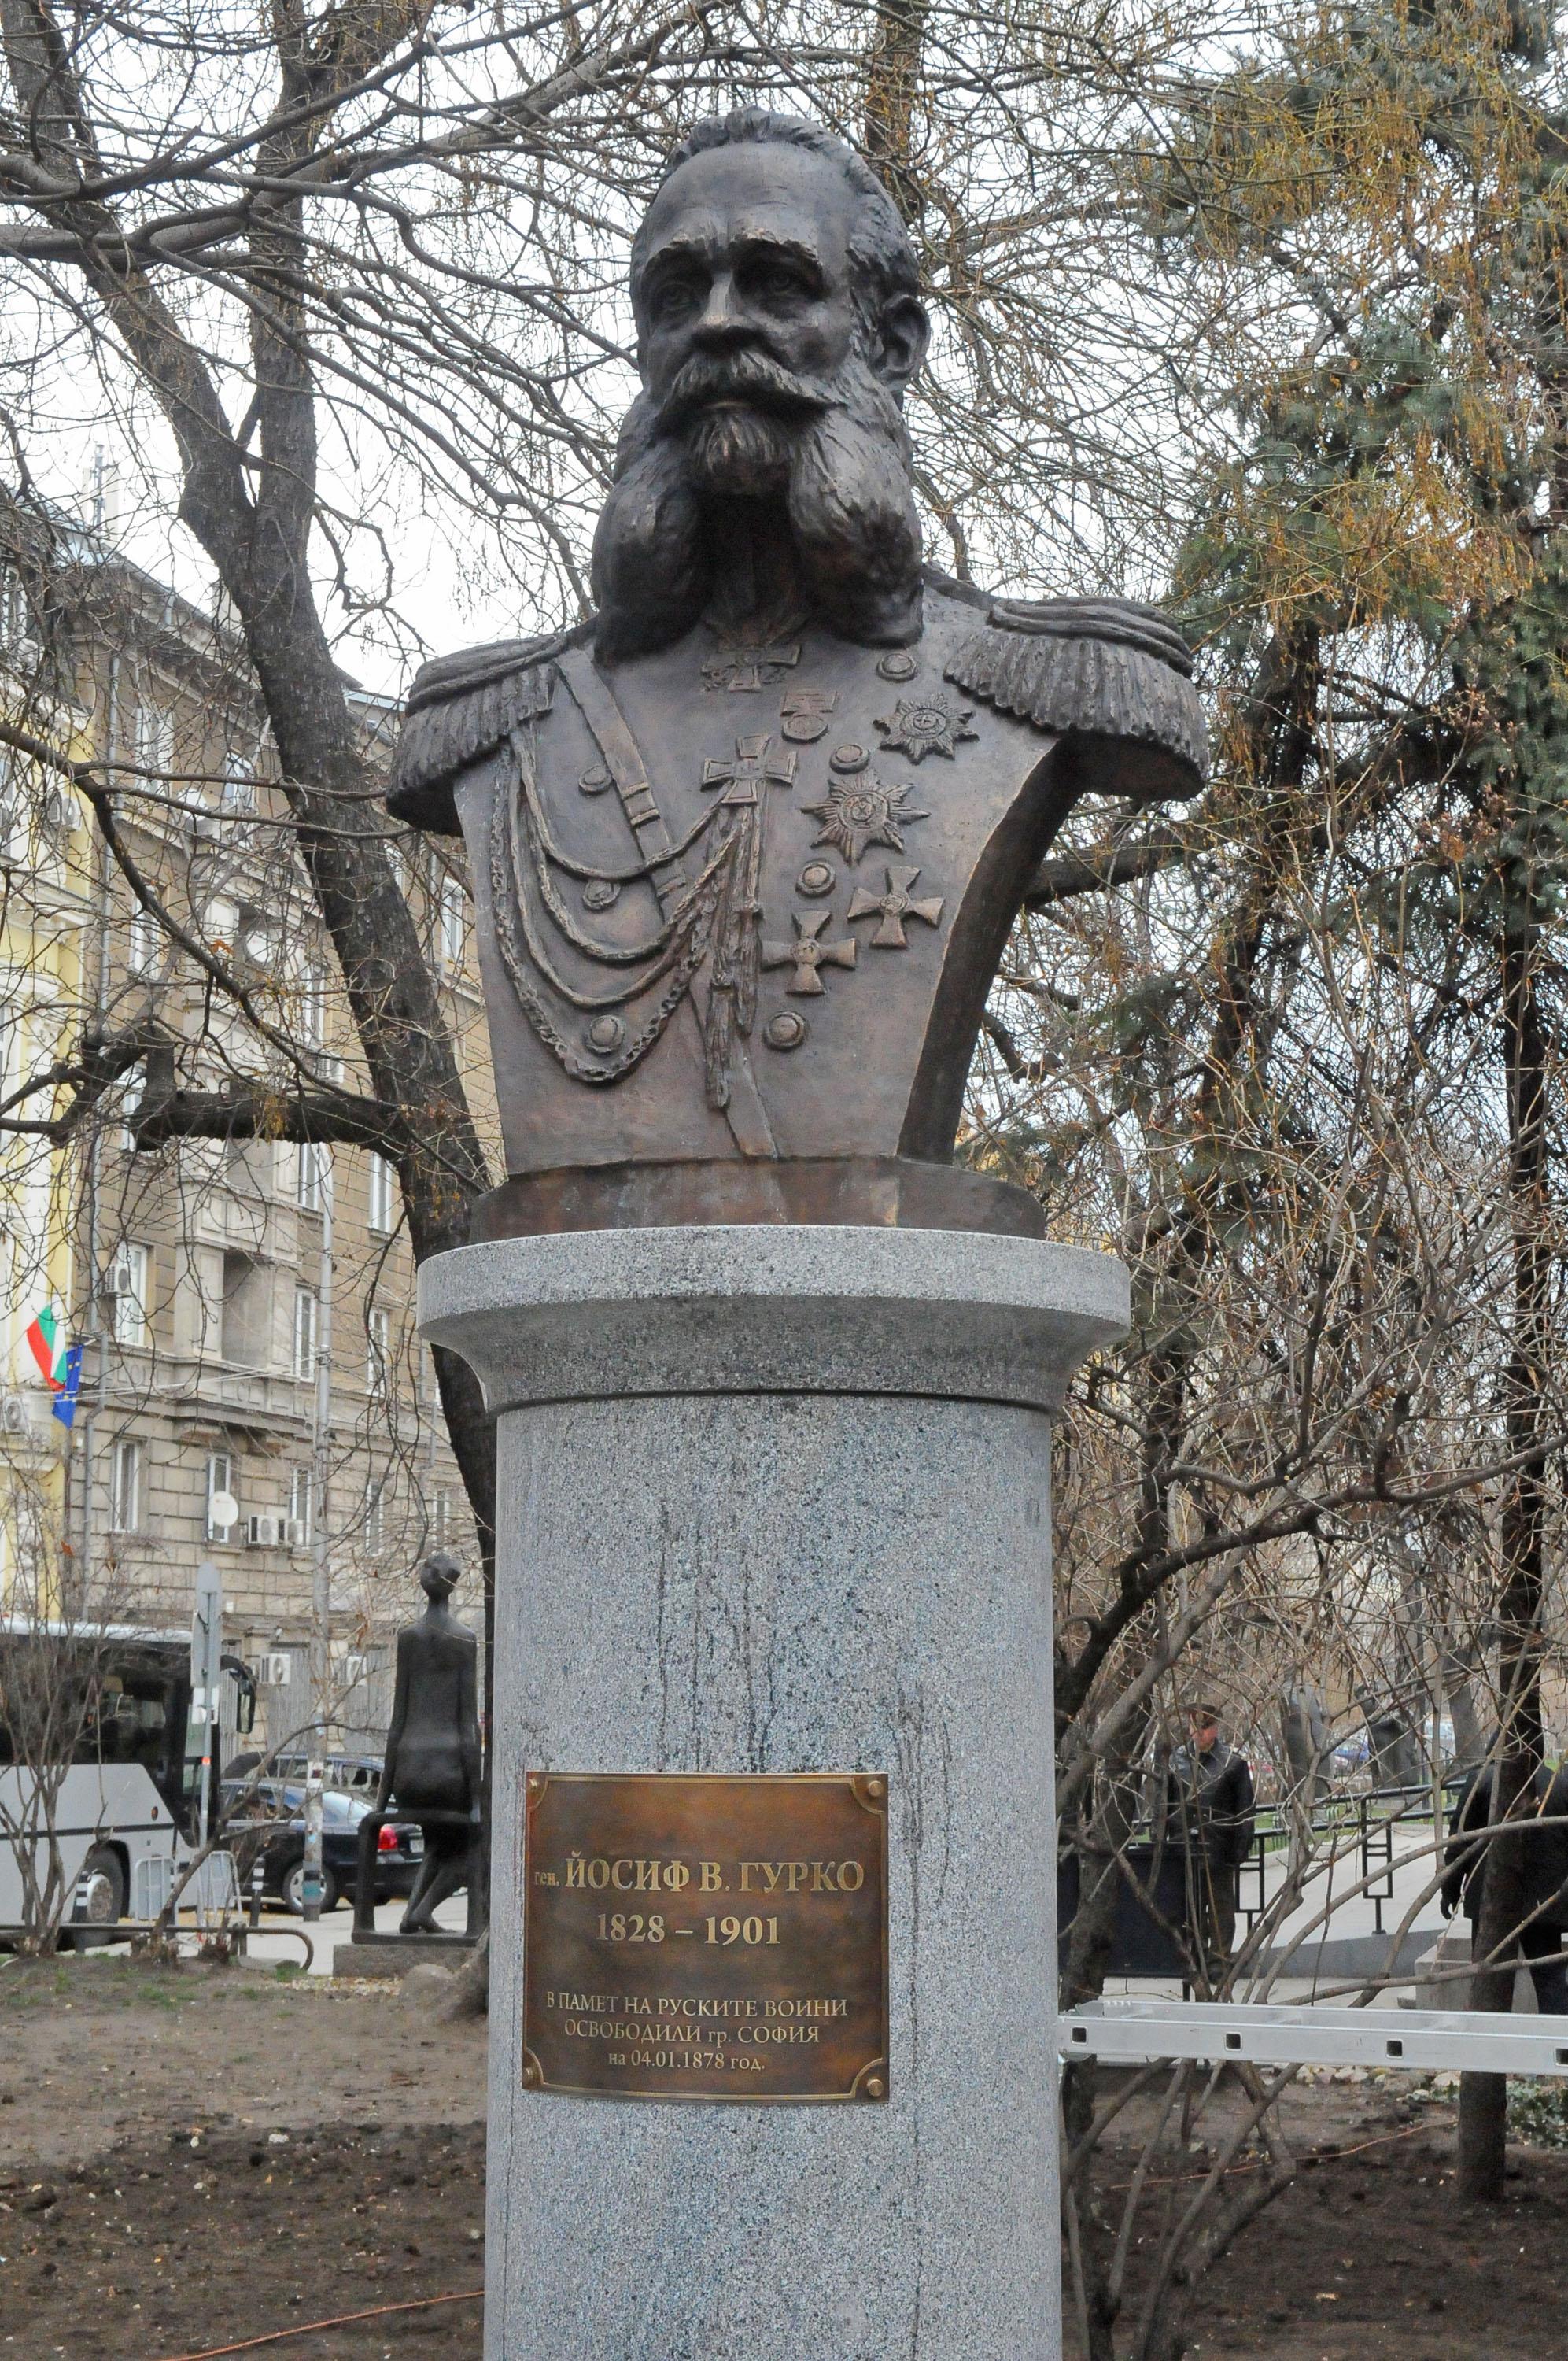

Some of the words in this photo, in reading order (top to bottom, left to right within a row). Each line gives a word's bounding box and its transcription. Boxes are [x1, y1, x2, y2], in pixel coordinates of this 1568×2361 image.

[534, 1871, 560, 1887] ген.
[564, 1850, 690, 1892] ЙОСИФ
[699, 1861, 730, 1892] В.
[738, 1860, 865, 1894] ГУРКО
[596, 1913, 666, 1943] 1828
[704, 1916, 781, 1945] 1901
[547, 1991, 555, 2008] В
[559, 1993, 618, 2013] ПАМЕТ
[625, 1997, 652, 2015] НА
[658, 1998, 758, 2017] РУСКИТЕ
[764, 1999, 847, 2017] ВОИНИ
[564, 2018, 702, 2045] ОСВОБОДИЛИ
[708, 2030, 732, 2049] гр.
[737, 2025, 820, 2044] СОФИЯ
[608, 2052, 626, 2066] на
[631, 2049, 725, 2070] 04.01.1878
[731, 2057, 766, 2071] год.
